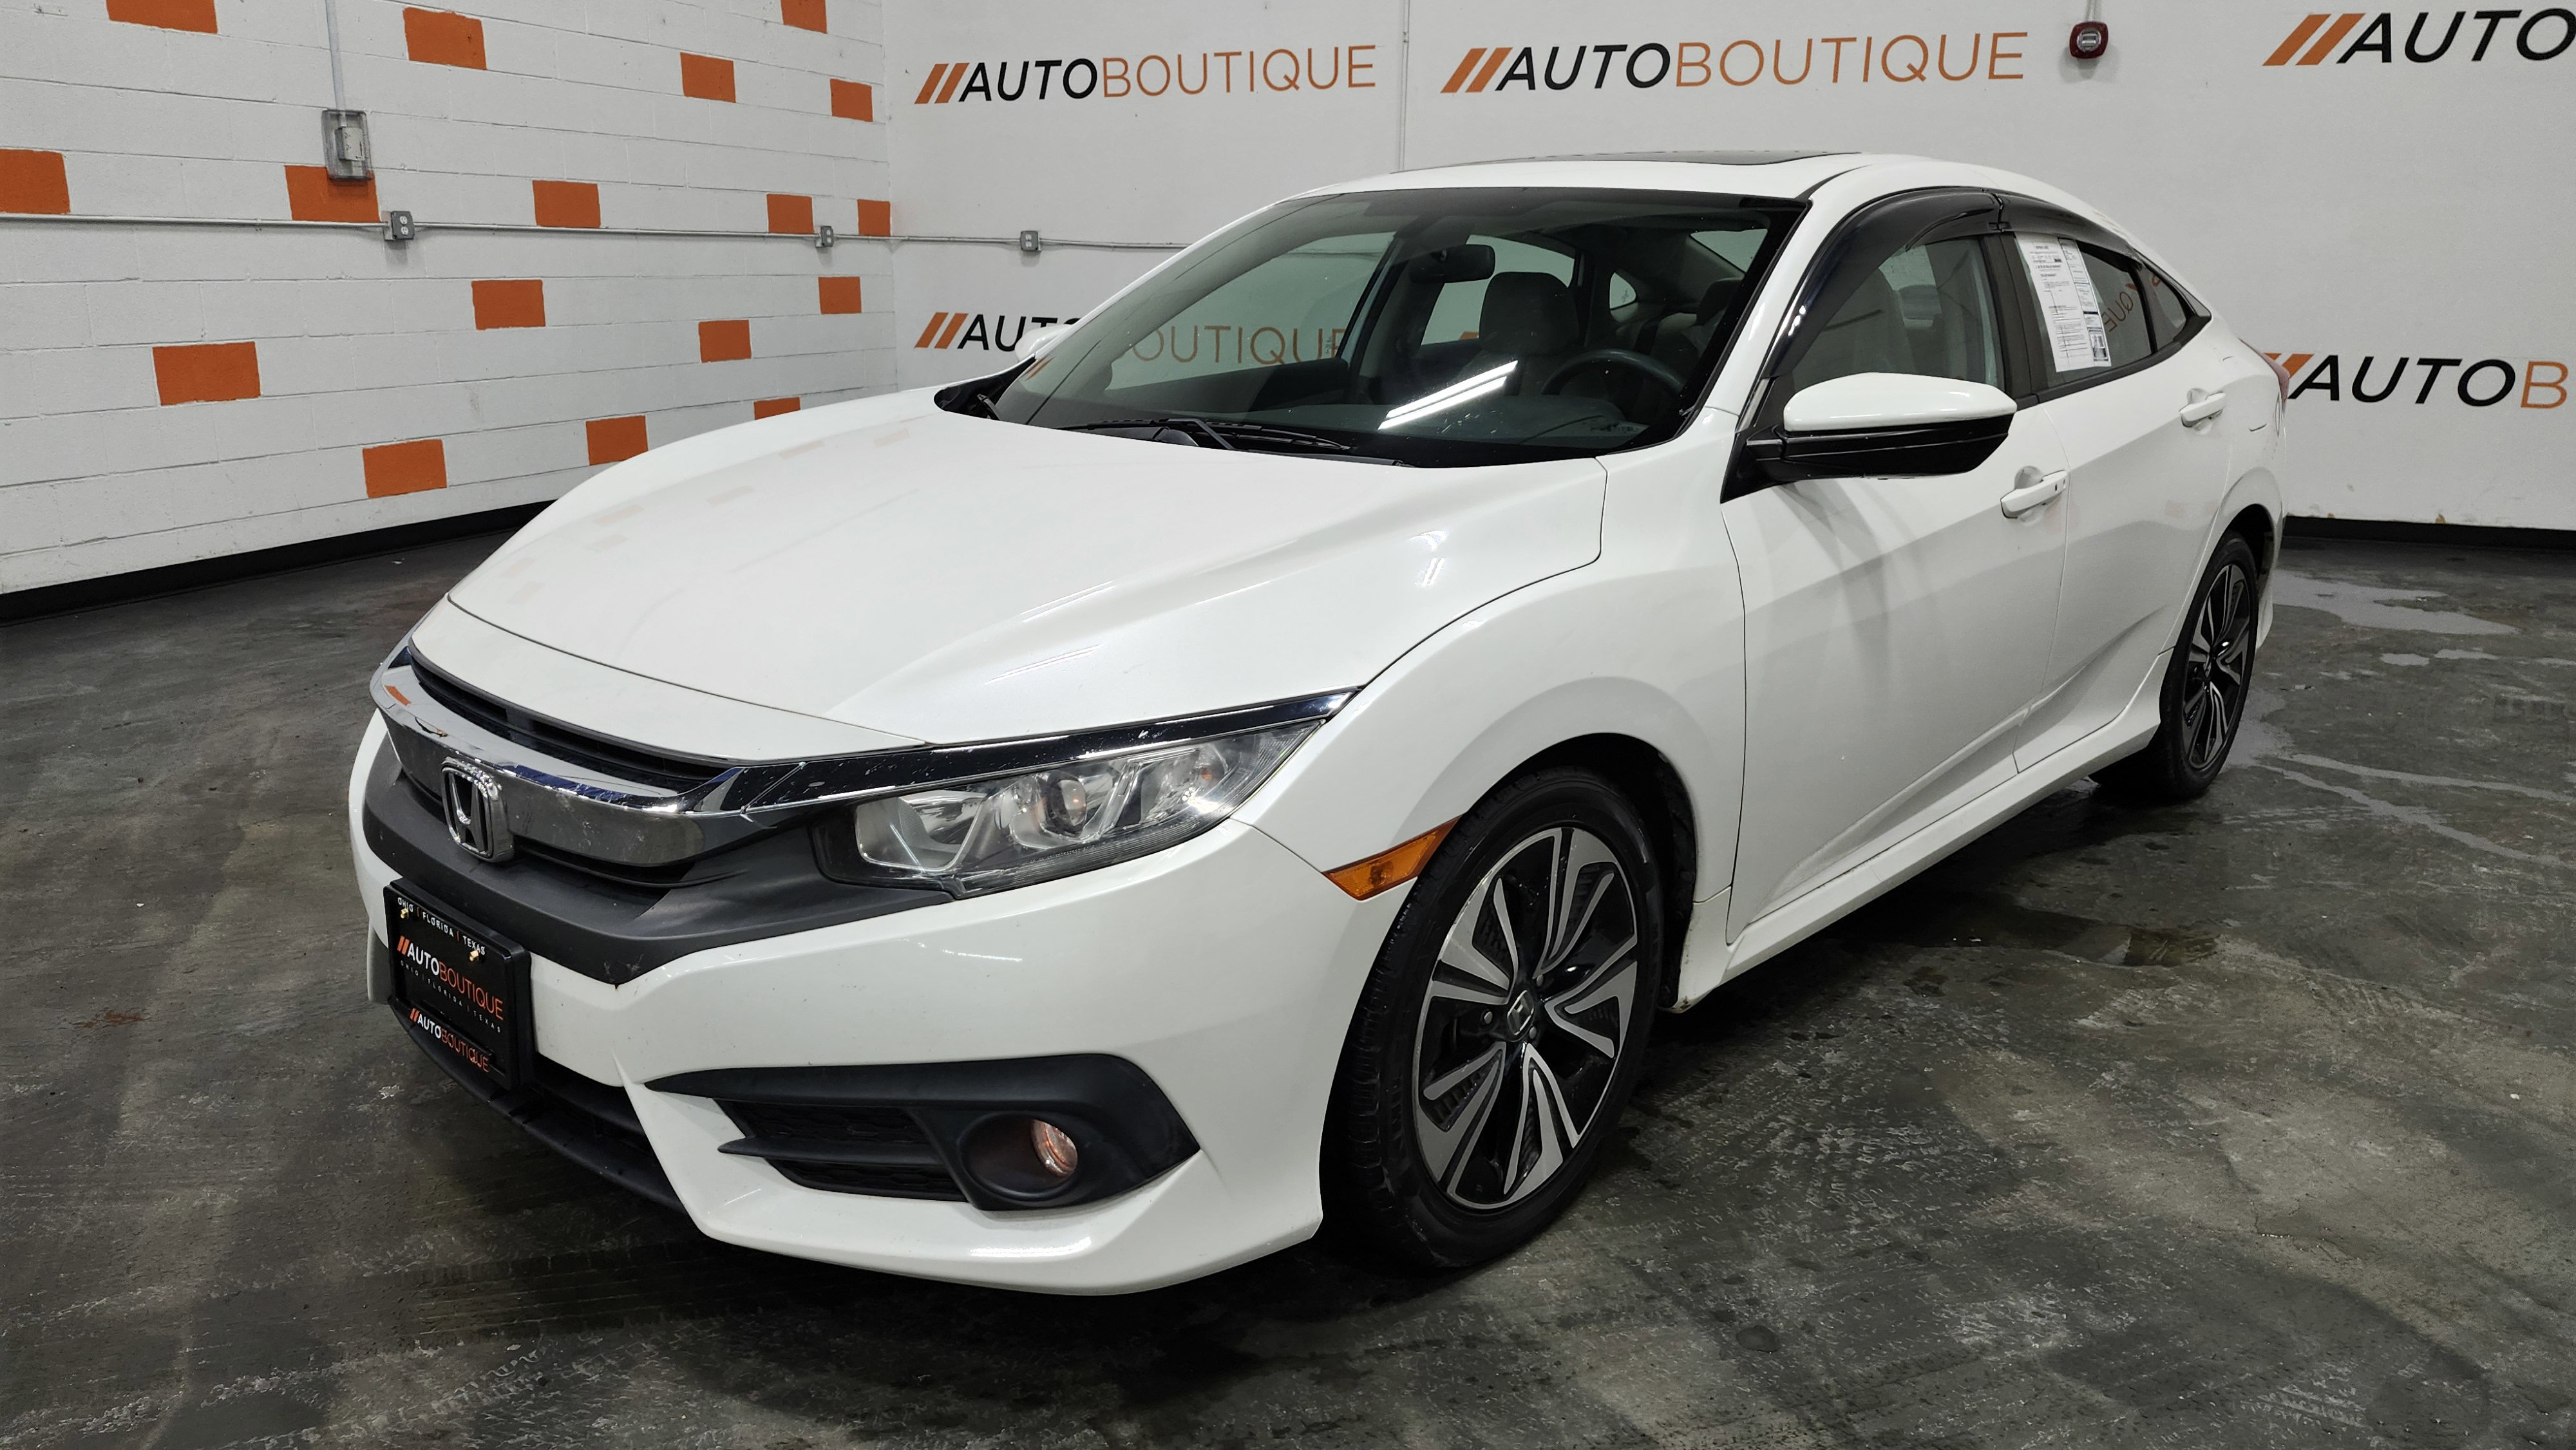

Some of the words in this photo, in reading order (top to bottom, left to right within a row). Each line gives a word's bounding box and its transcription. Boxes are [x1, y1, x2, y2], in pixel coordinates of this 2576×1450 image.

[958, 45, 1376, 102] AUTOBOUTIQUE
[1495, 32, 2027, 91] AUTOBOUTIQUE
[422, 911, 453, 937] FLORIDA
[462, 935, 486, 956] TEXAS
[407, 943, 504, 1021] AUTOBOUTIQUE
[417, 1013, 489, 1073] AUTOBOUTIQUE
[473, 1010, 500, 1033] TEXAS
